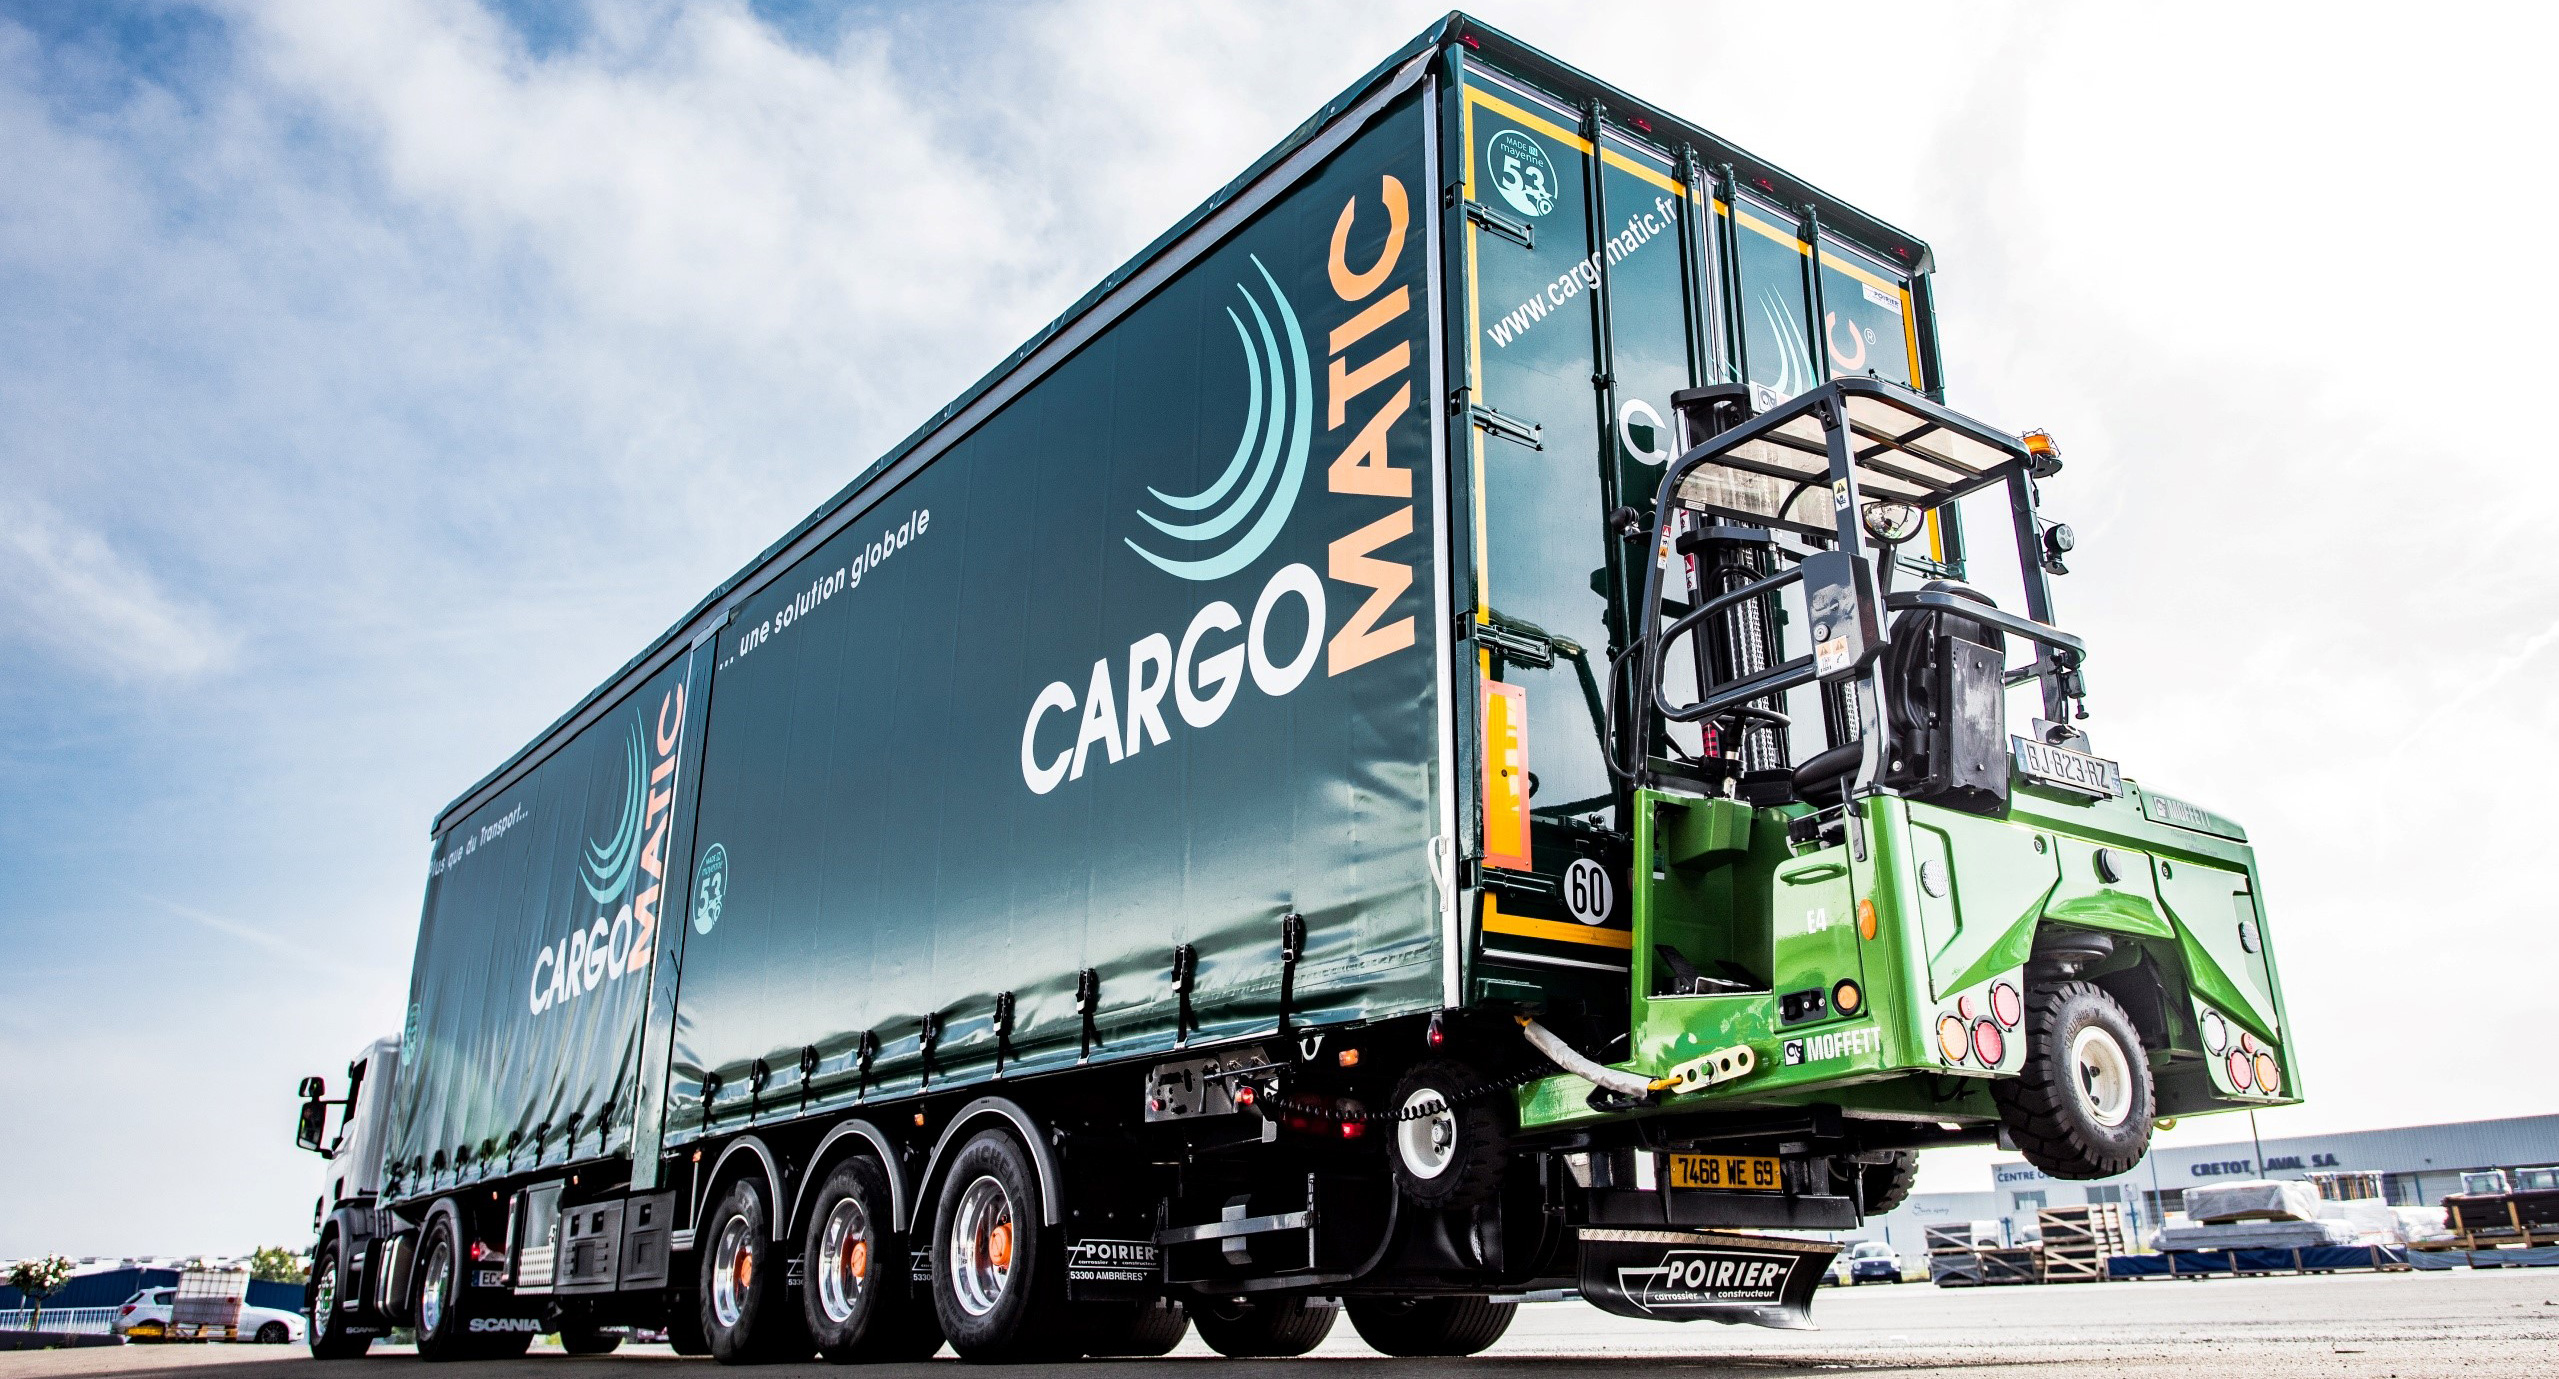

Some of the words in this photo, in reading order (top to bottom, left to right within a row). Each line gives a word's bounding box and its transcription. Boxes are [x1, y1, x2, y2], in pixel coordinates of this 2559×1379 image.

[1500, 143, 1544, 168] mayenne
[1506, 136, 1527, 151] MADE
[1501, 154, 1546, 195] 53
[1327, 174, 1416, 678] MATIC
[739, 620, 769, 656] une
[774, 568, 845, 633] solution
[851, 509, 930, 588] globale
[1021, 562, 1327, 795] CARGO
[627, 683, 684, 974] MATIC
[447, 845, 463, 870] que
[465, 834, 478, 855] du
[697, 871, 722, 918] 53
[1572, 863, 1604, 918] 60
[1806, 907, 1828, 934] E4
[530, 904, 633, 1016] CARGO
[1805, 1026, 1882, 1062] MOFFETT
[1678, 1158, 1721, 1185] 7468
[1726, 1159, 1748, 1186] WE
[1753, 1160, 1774, 1186] 69
[1996, 1170, 2035, 1183] CENTRE
[1085, 1243, 1155, 1261] POIRIER
[1070, 1270, 1095, 1281] 53300
[1095, 1269, 1144, 1282] AMBRIÈRES
[1666, 1259, 1780, 1289] POIRIER
[1654, 1290, 1698, 1301] carrossier
[1717, 1289, 1776, 1299] constructeur
[469, 1318, 542, 1332] SCANIA
